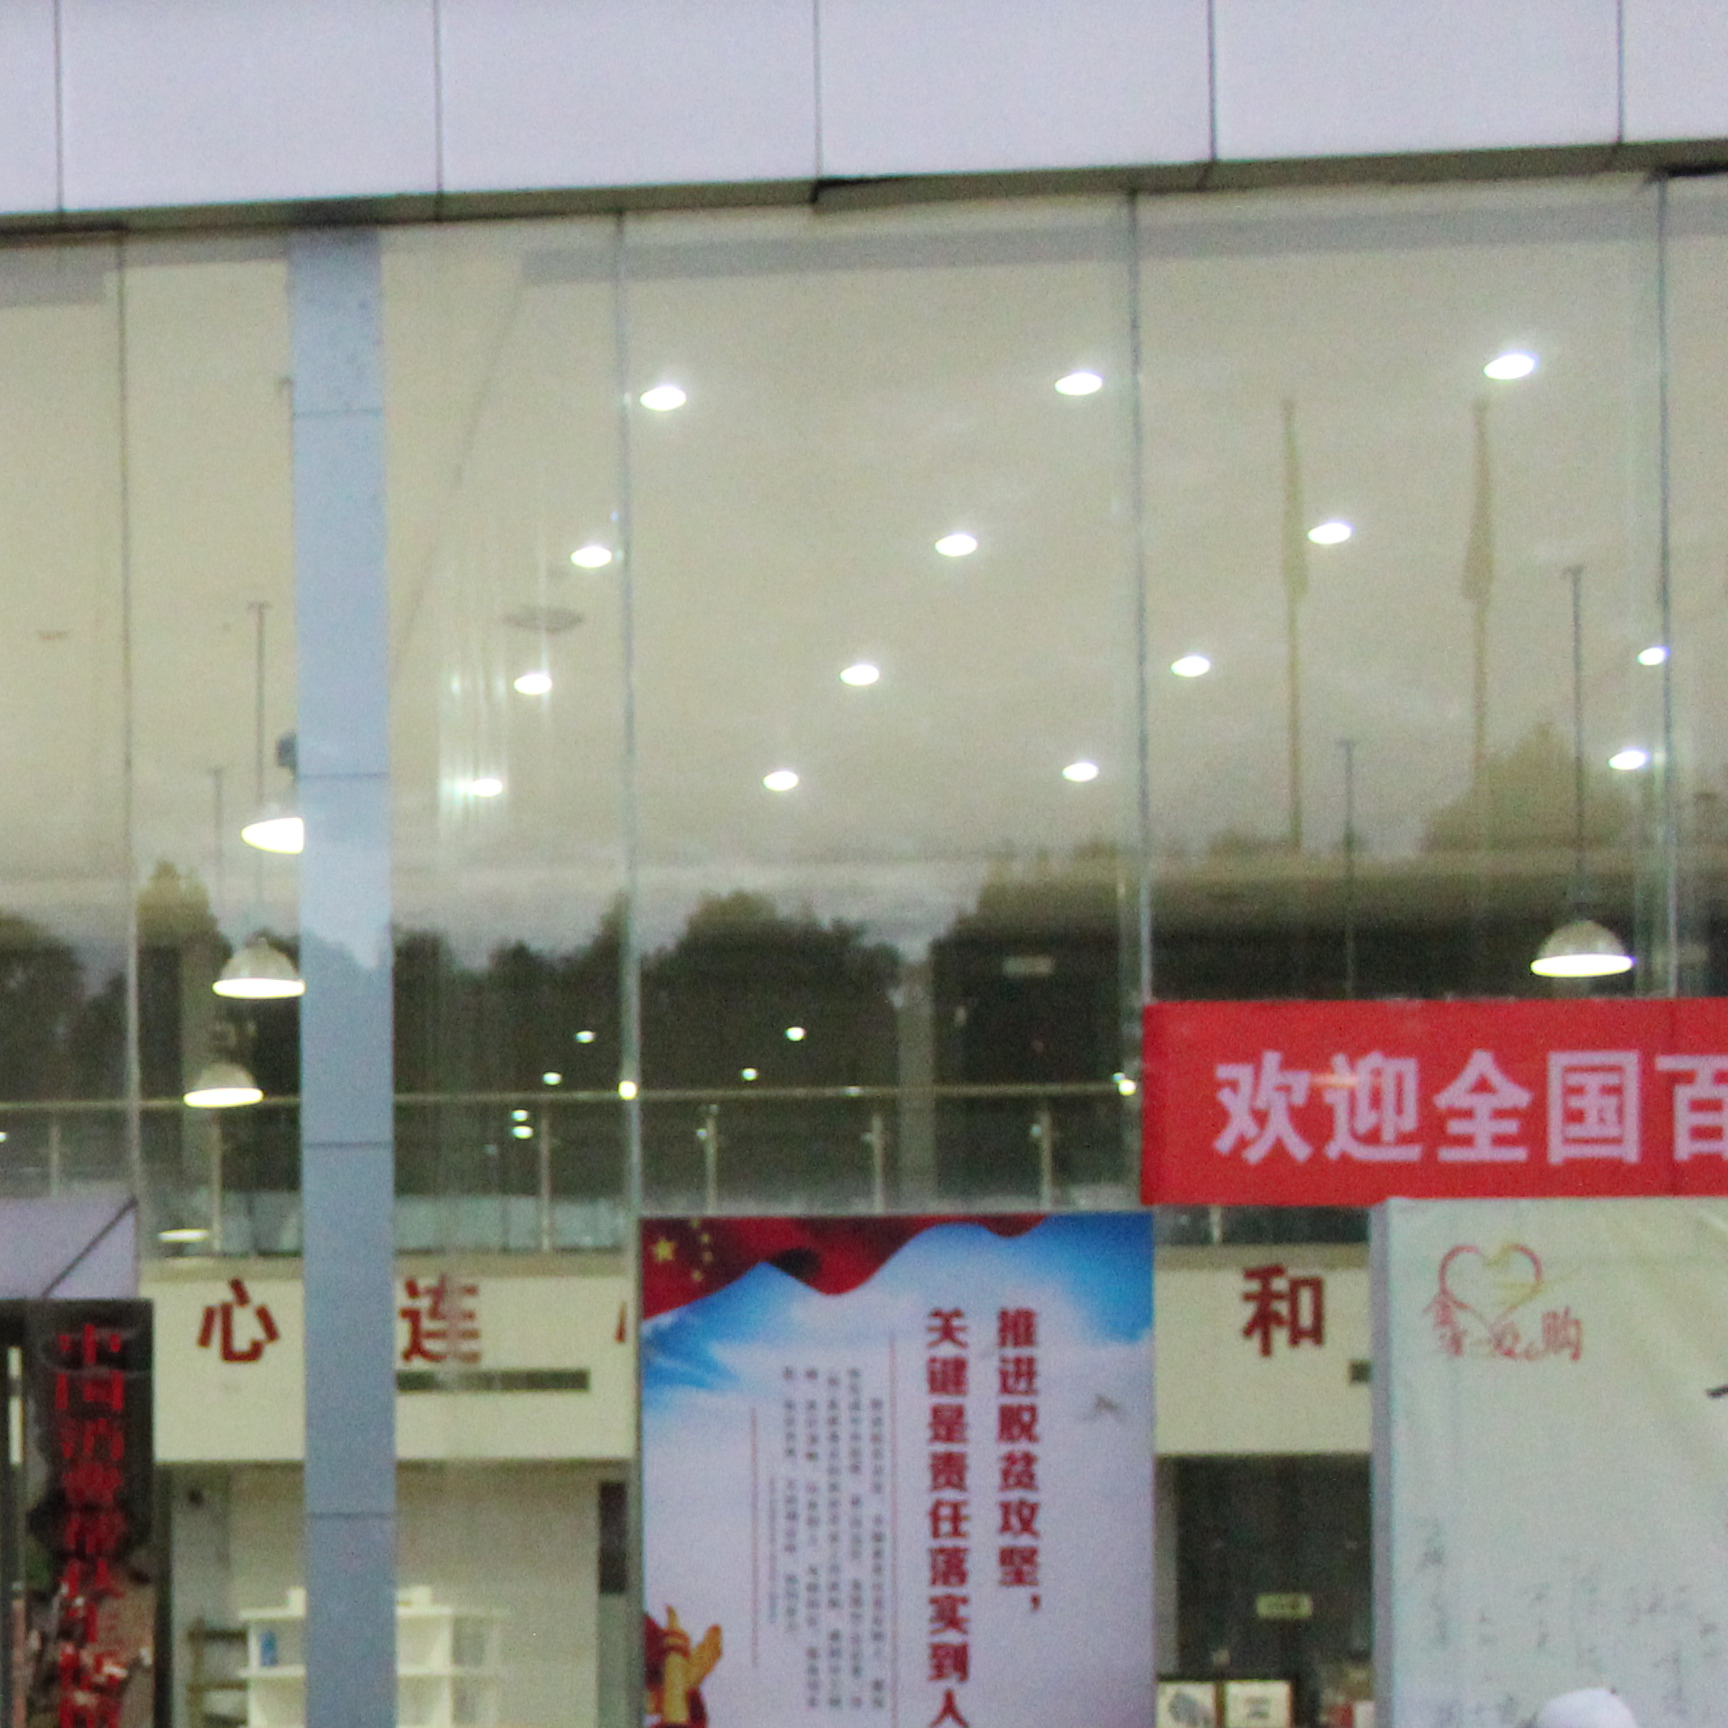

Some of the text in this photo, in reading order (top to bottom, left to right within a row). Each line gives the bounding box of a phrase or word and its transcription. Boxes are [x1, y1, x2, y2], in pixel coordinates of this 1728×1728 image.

[1213, 1048, 1728, 1166] 欢迎全国百
[198, 1278, 280, 1363] 心
[1241, 1263, 1326, 1358] 和
